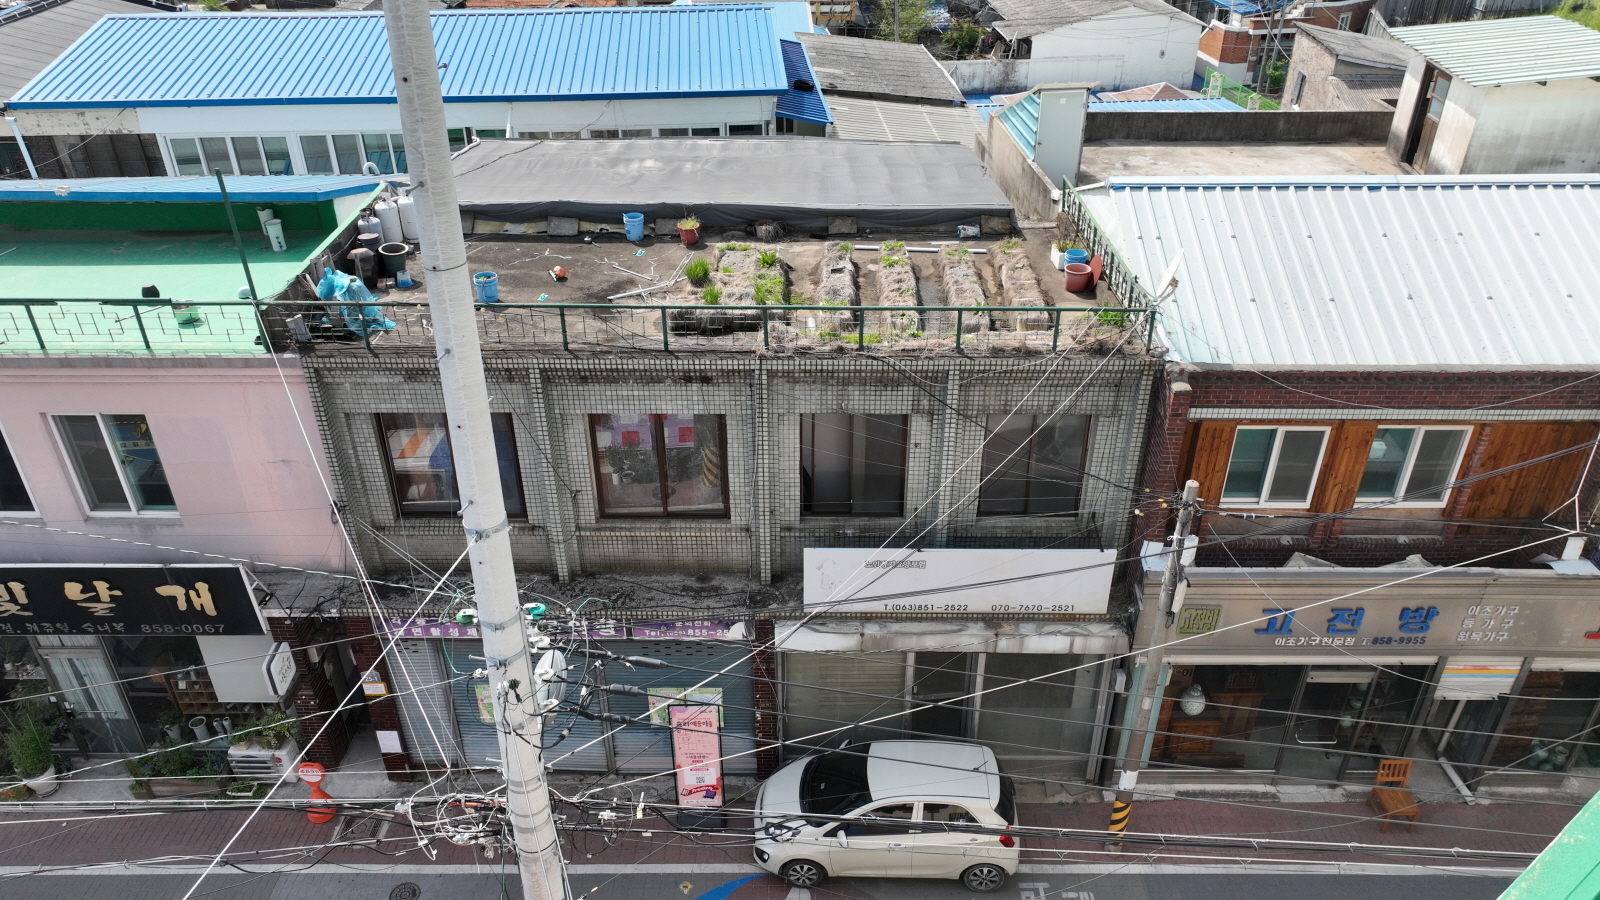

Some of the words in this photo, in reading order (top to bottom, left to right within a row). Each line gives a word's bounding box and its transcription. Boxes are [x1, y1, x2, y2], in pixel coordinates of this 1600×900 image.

[991, 604, 1075, 612] 070-7670-2521
[1467, 605, 1519, 616] 이조가구
[141, 624, 225, 633] 858-0067
[1372, 636, 1427, 645] 858-9955
[1457, 631, 1508, 642] 원목가구
